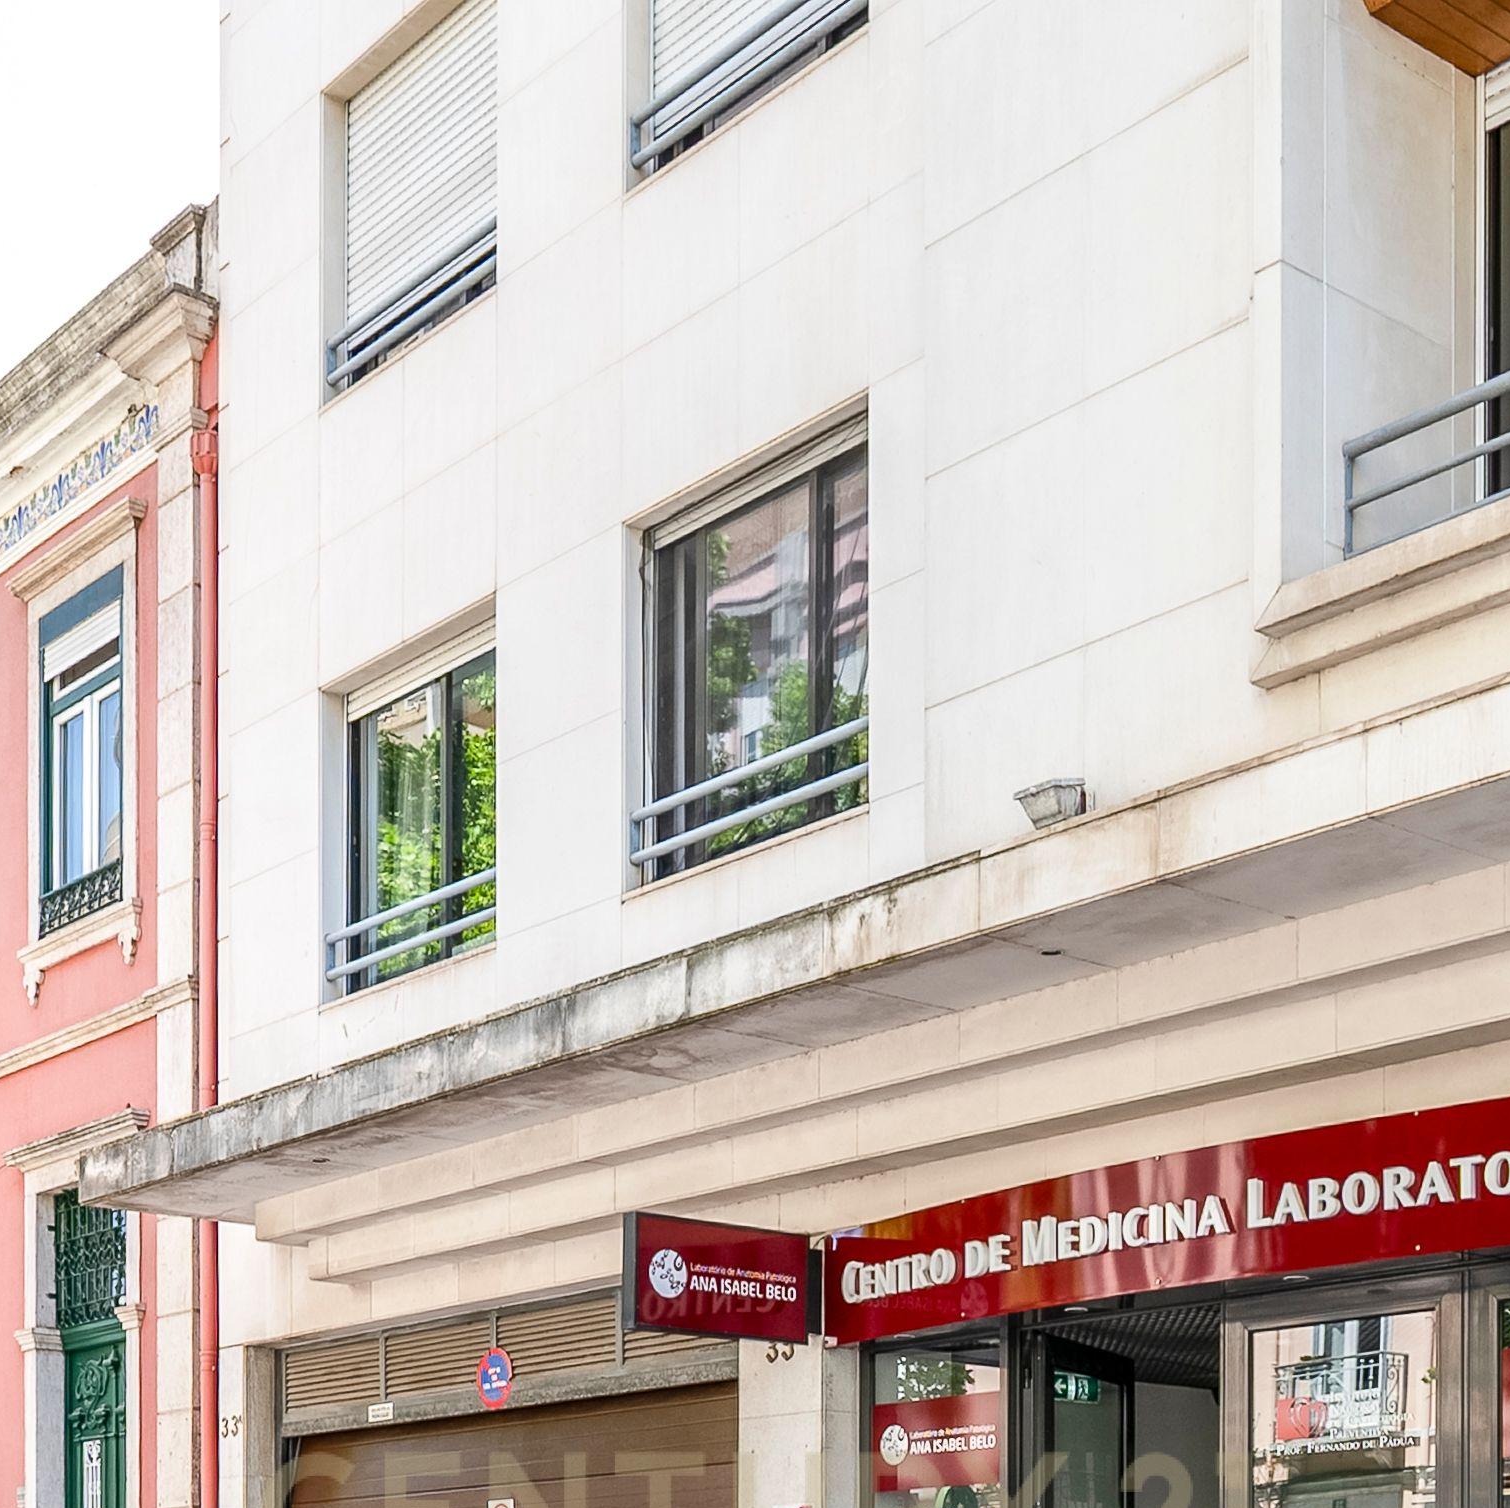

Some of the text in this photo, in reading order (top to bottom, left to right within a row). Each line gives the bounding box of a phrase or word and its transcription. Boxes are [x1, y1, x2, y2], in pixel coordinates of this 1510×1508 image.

[842, 1247, 957, 1304] CENTRO
[964, 1234, 1012, 1279] DE
[1021, 1194, 1233, 1267] MEDICINA
[690, 1274, 797, 1302] ANA ISABEL BELO
[909, 1433, 996, 1455] ANA ISABEL BELO
[1306, 1439, 1361, 1455] FERNANDO
